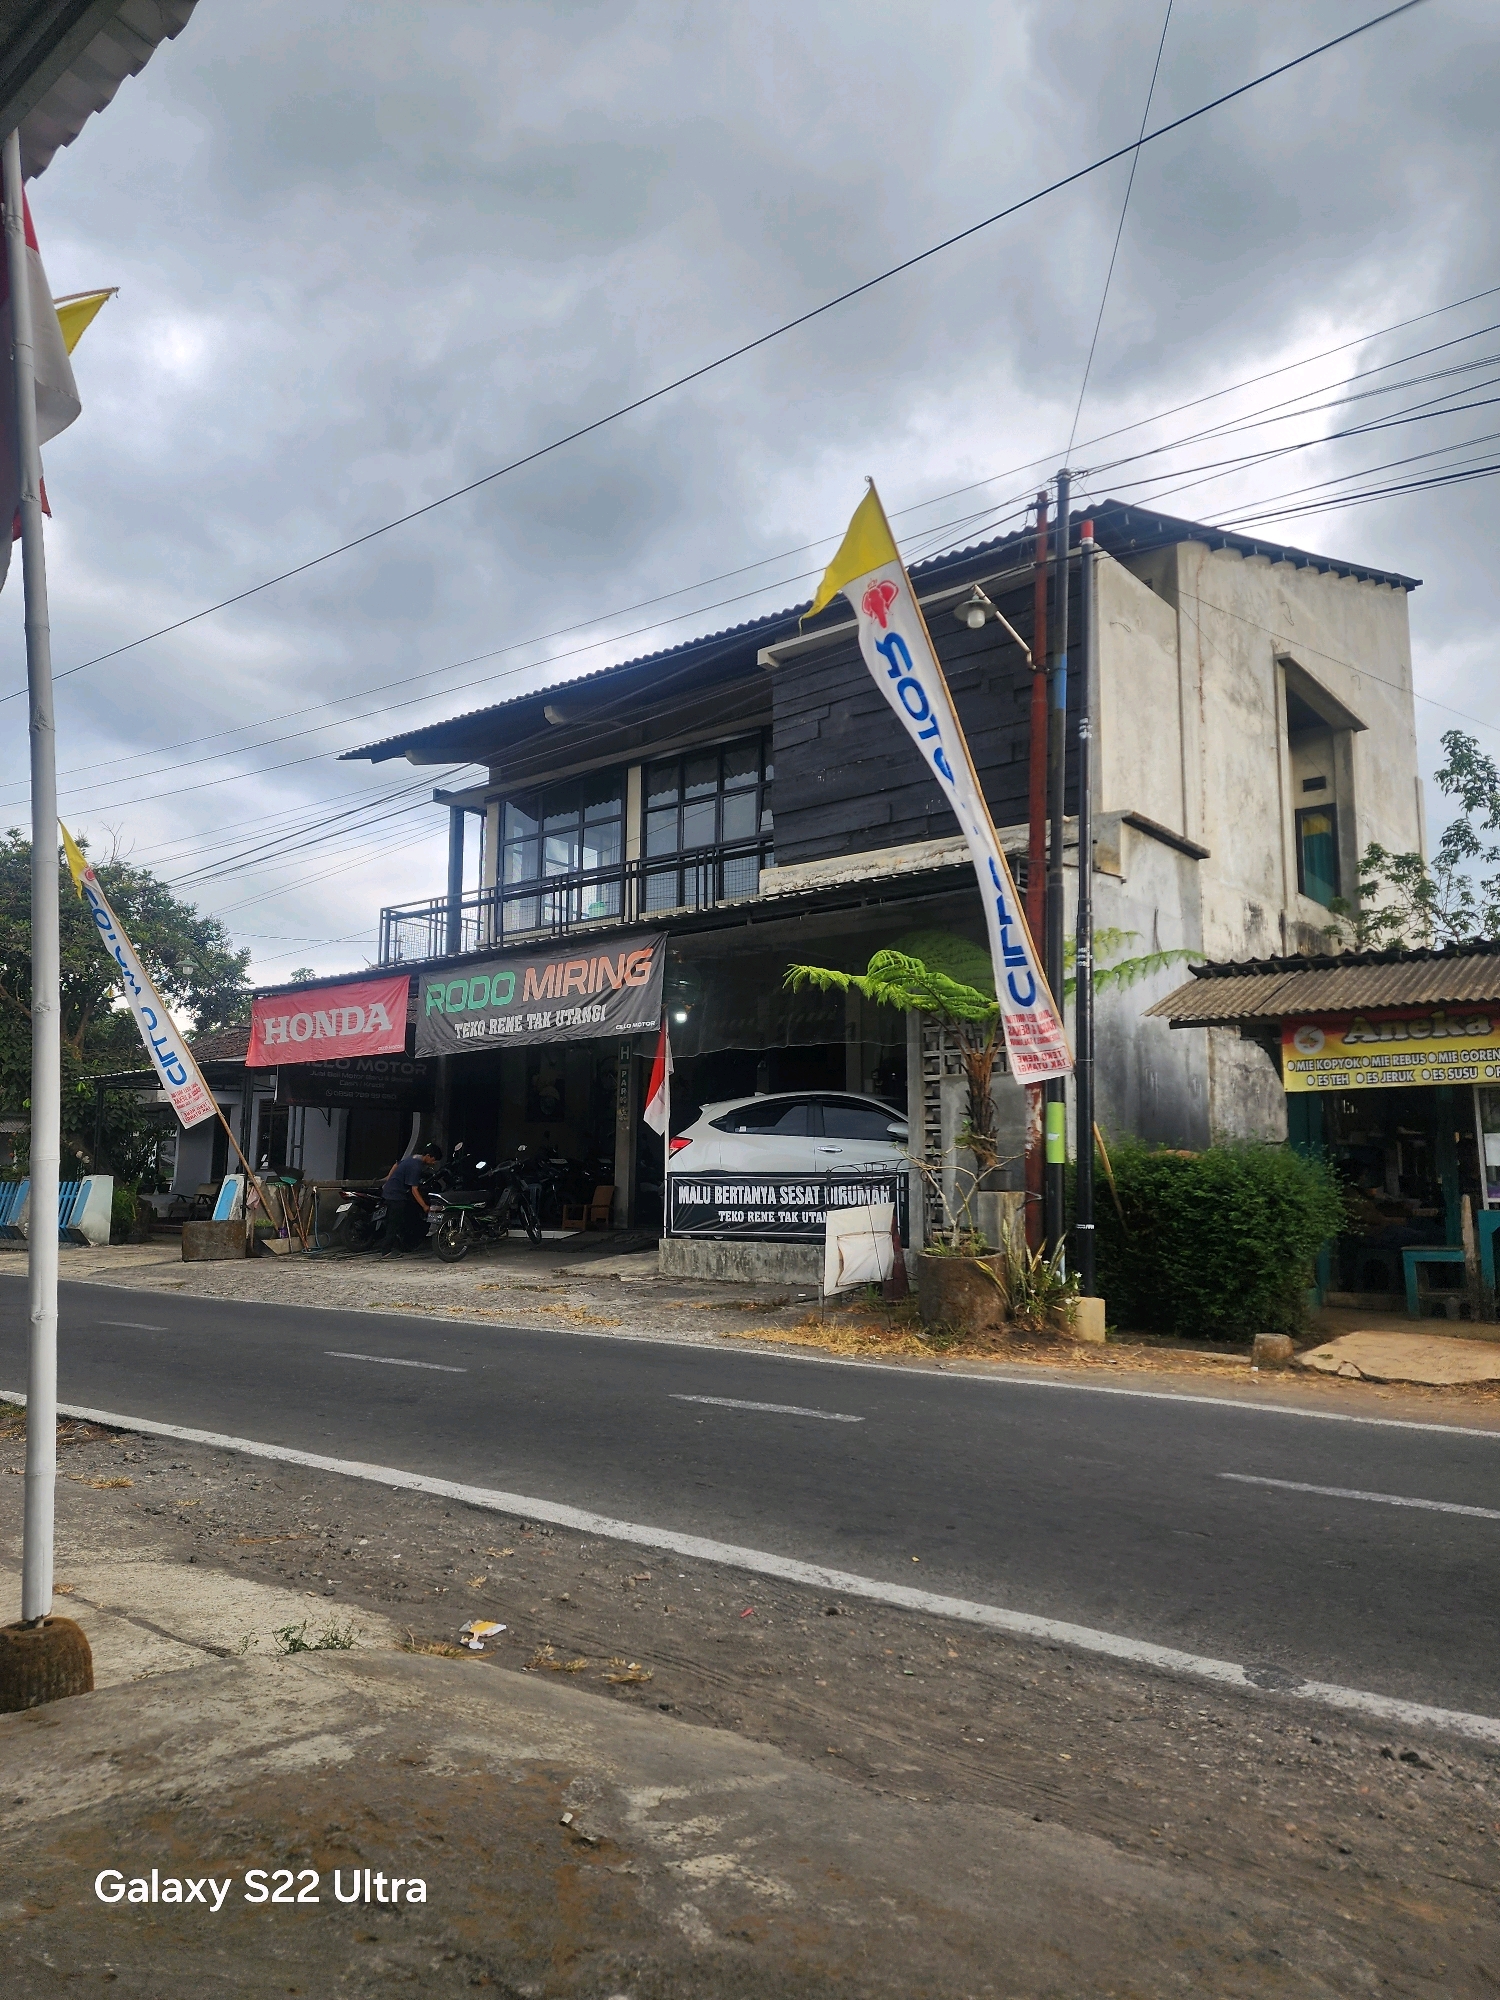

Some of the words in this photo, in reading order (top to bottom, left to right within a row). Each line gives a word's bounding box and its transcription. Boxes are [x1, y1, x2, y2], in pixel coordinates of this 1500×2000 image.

[424, 971, 516, 1016] RODO
[522, 947, 654, 1002] MIRING
[263, 1003, 393, 1045] HONDA
[454, 1020, 485, 1039] TEKO
[489, 1017, 522, 1036] RENE
[527, 1013, 552, 1032] TAK
[555, 1004, 607, 1027] UTANGI
[1342, 1010, 1493, 1044] Aneka
[1296, 1060, 1314, 1071] MIE
[1316, 1058, 1361, 1070] KOPYOK
[1371, 1056, 1390, 1067] MIE
[1393, 1053, 1427, 1066] REBUS
[1438, 1051, 1458, 1063] MIE
[1318, 1074, 1329, 1086] ES
[1331, 1073, 1349, 1086] TEH
[1366, 1072, 1379, 1084] ES
[1381, 1070, 1415, 1084] JERUK
[1432, 1069, 1444, 1080] ES
[1447, 1066, 1478, 1080] SUSU
[678, 1185, 711, 1205] MALU
[714, 1185, 776, 1205] BERTANYA
[780, 1185, 820, 1205] SESAT
[718, 1210, 744, 1223] TEKO
[747, 1211, 776, 1223] RENE
[778, 1211, 799, 1223] TAK
